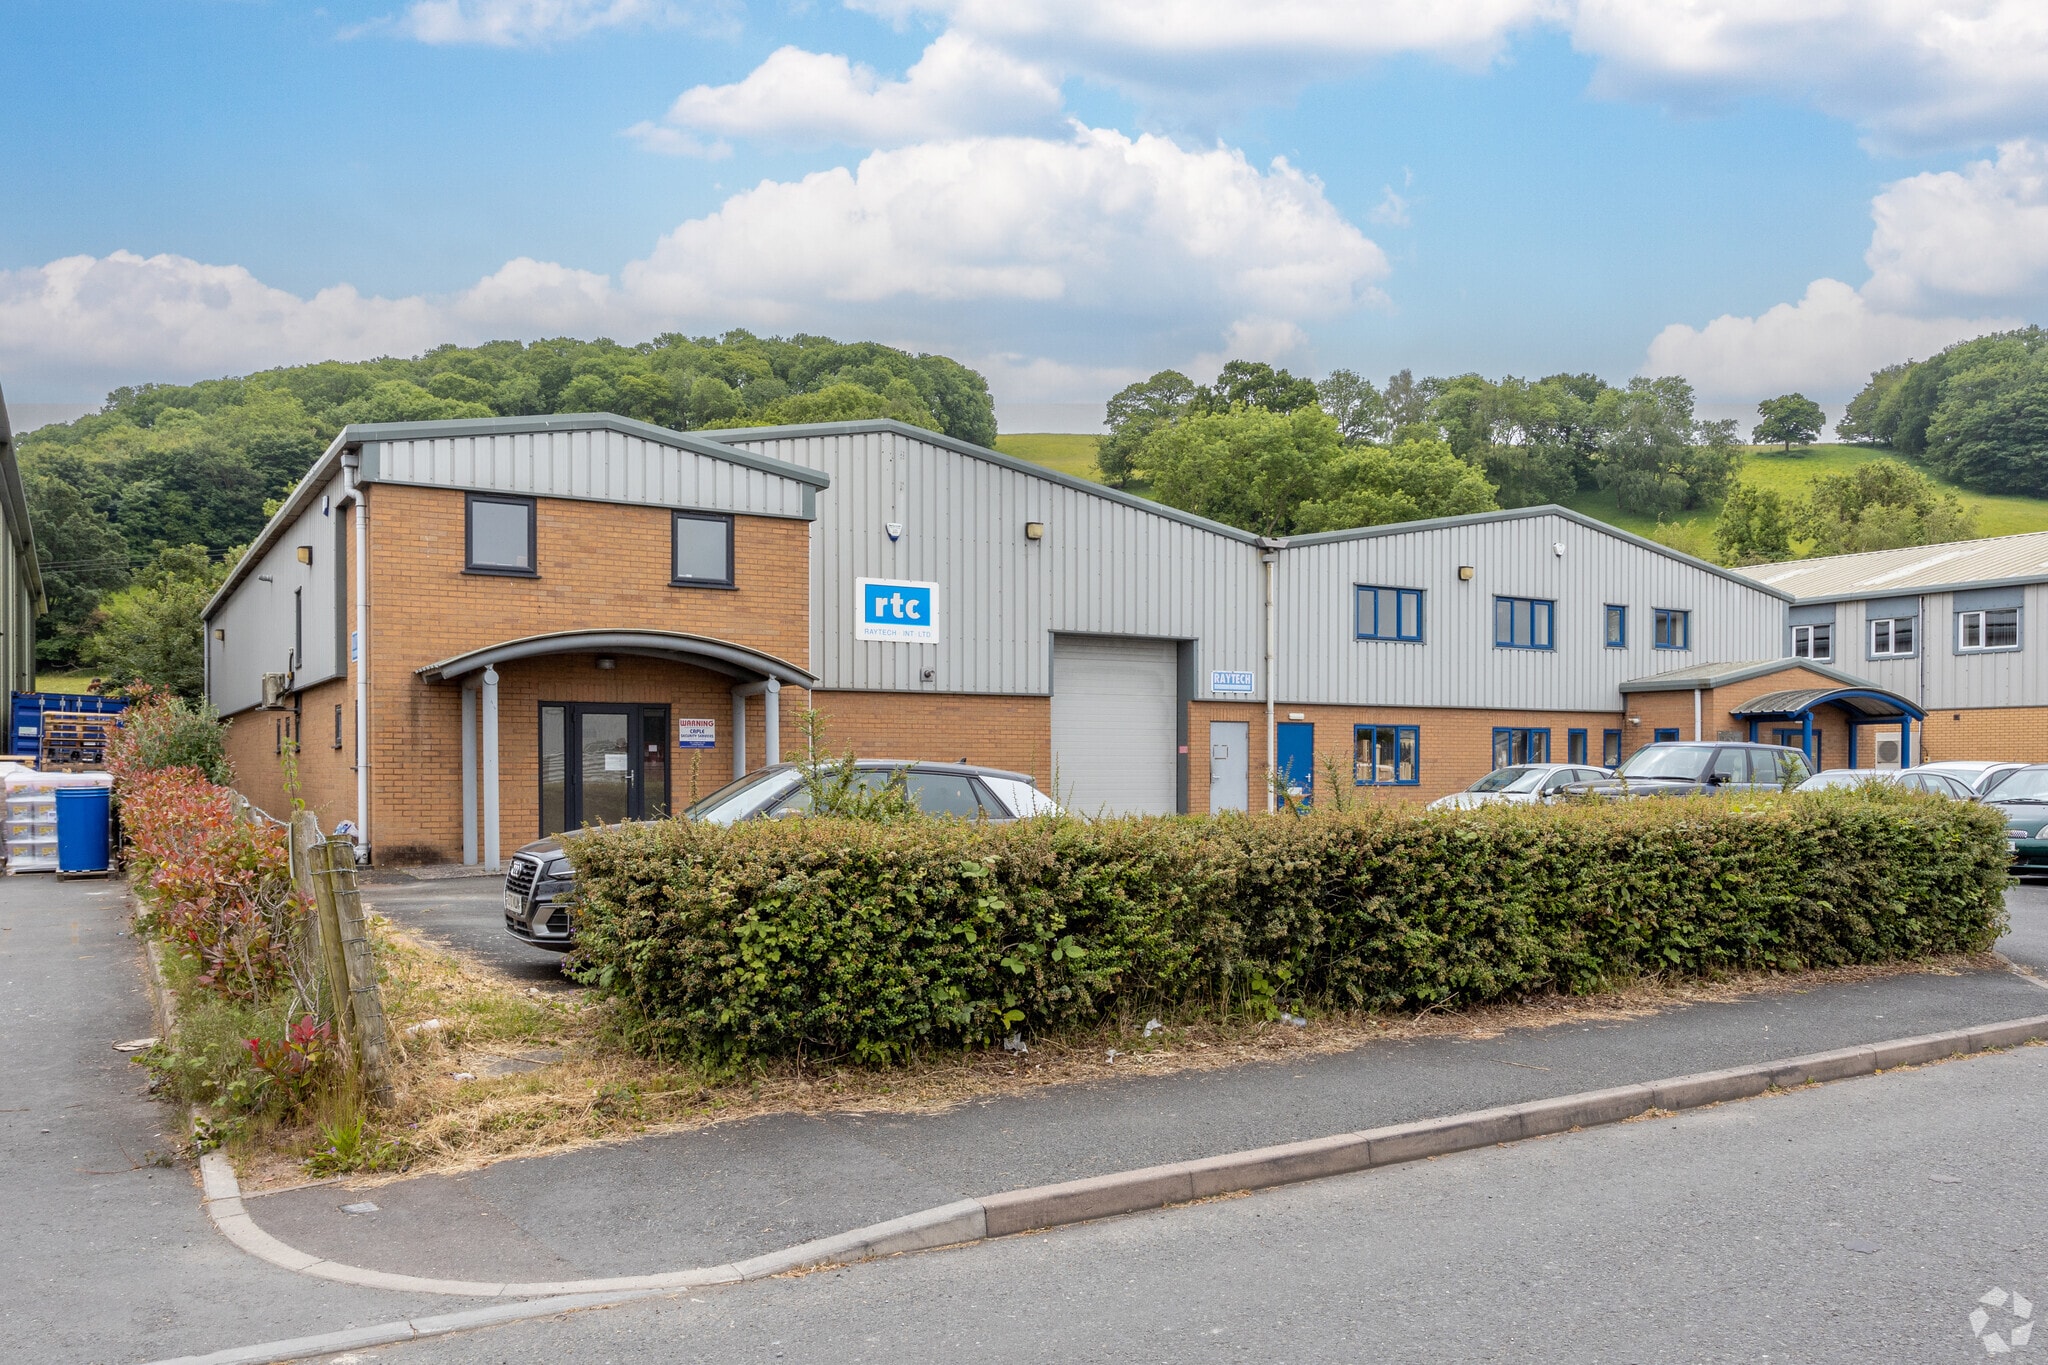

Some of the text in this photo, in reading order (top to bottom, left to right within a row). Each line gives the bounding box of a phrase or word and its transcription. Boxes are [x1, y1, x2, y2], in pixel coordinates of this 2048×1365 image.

[875, 592, 921, 620] rtc
[864, 628, 897, 636] RAYTECH
[1214, 673, 1251, 684] RAYTECH
